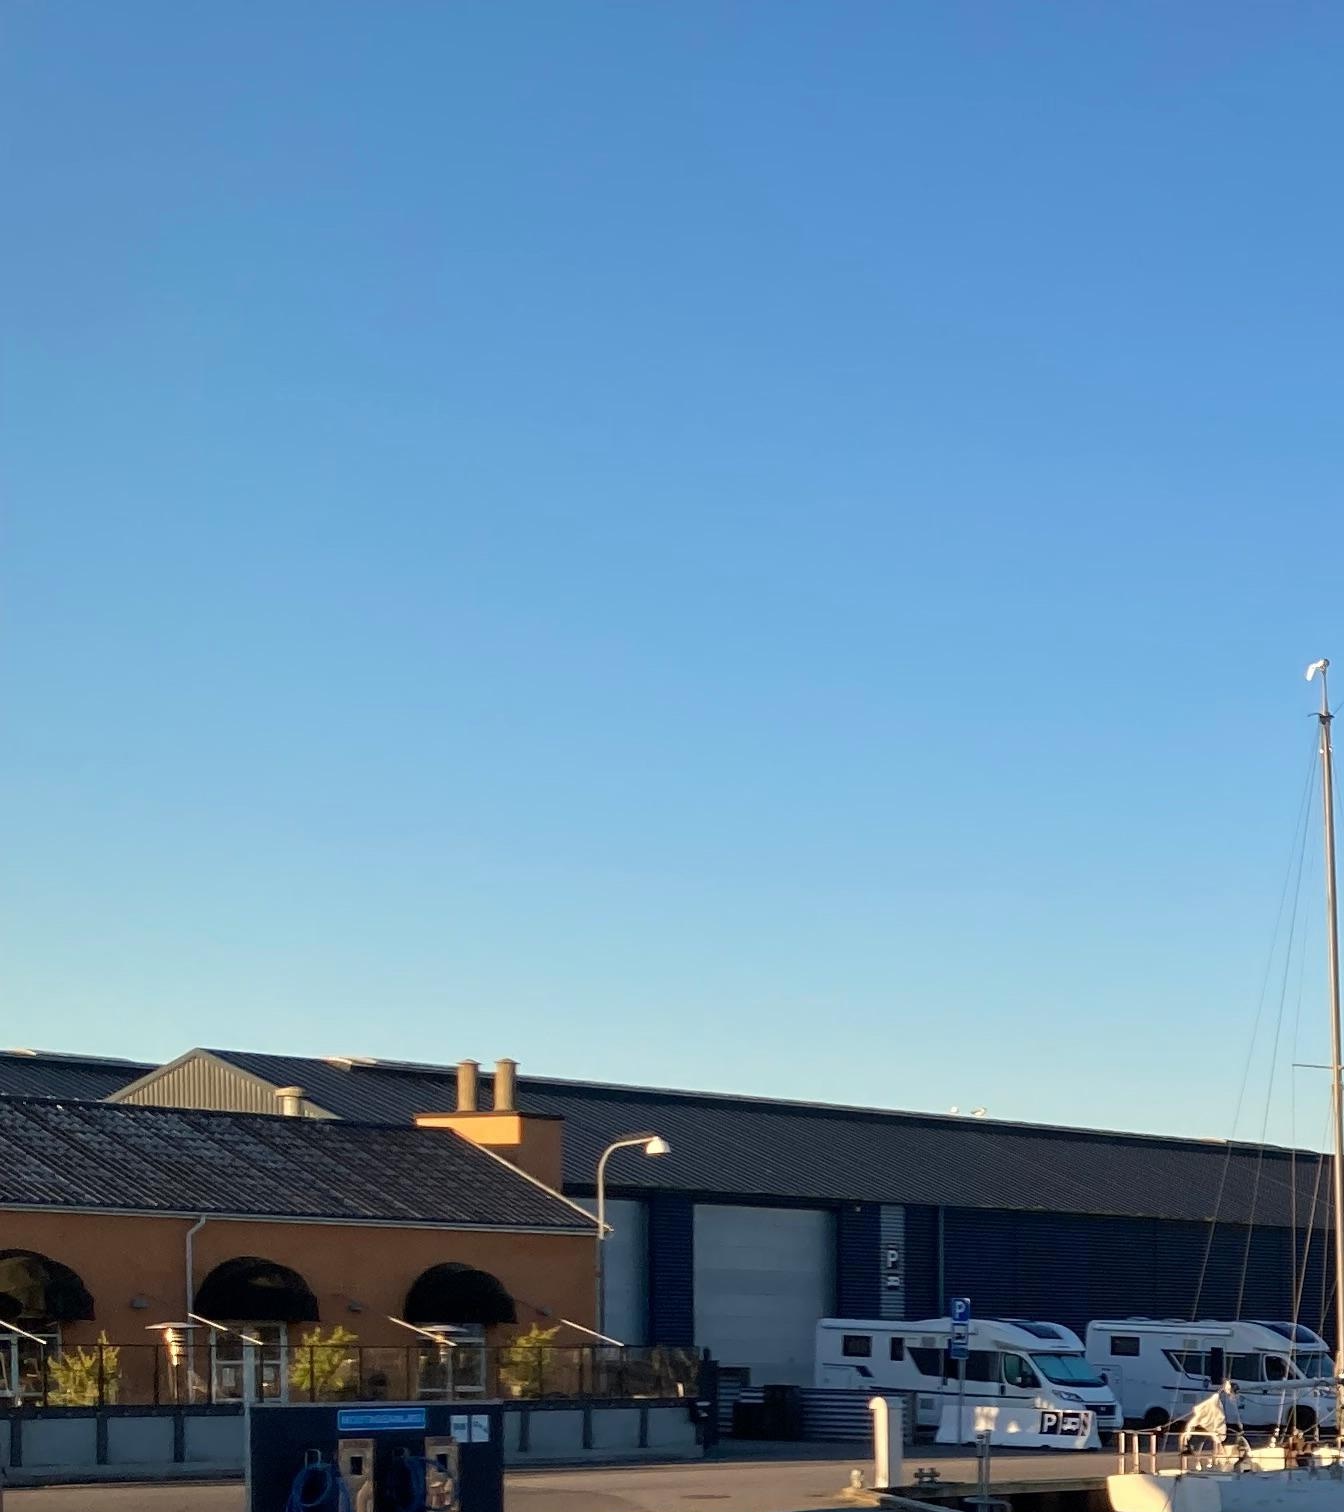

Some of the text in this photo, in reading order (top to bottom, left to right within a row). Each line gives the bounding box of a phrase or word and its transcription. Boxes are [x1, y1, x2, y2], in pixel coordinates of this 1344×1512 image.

[886, 1249, 898, 1268] P
[955, 1301, 966, 1319] P
[1042, 1413, 1057, 1433] P
